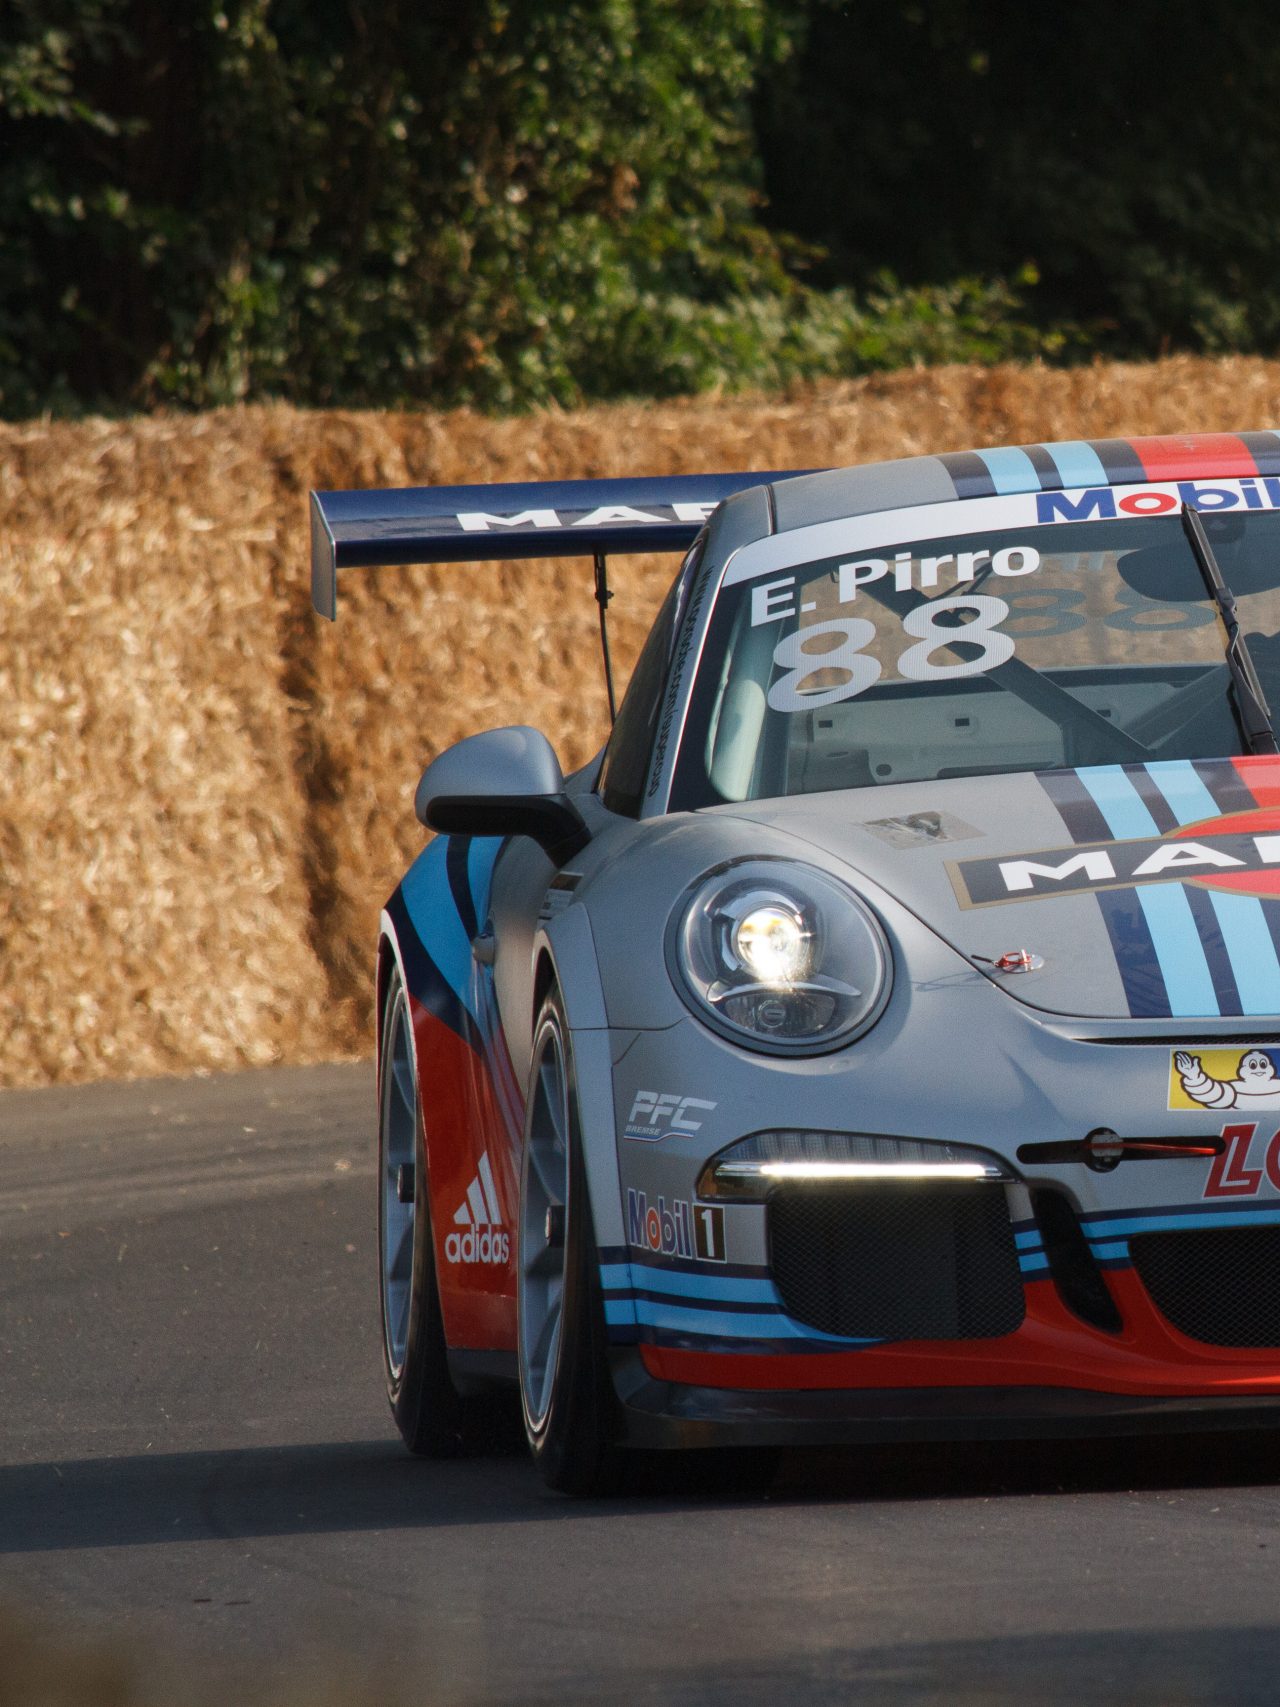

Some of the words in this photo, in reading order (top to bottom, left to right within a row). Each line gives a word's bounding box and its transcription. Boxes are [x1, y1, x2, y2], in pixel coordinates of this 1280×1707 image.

[751, 576, 817, 627] E.
[839, 546, 1040, 603] Pirro
[767, 594, 1016, 713] 88
[629, 1090, 719, 1131] PFC
[445, 1223, 510, 1265] adidas
[627, 1188, 693, 1260] Mobil
[700, 1208, 716, 1258] 1
